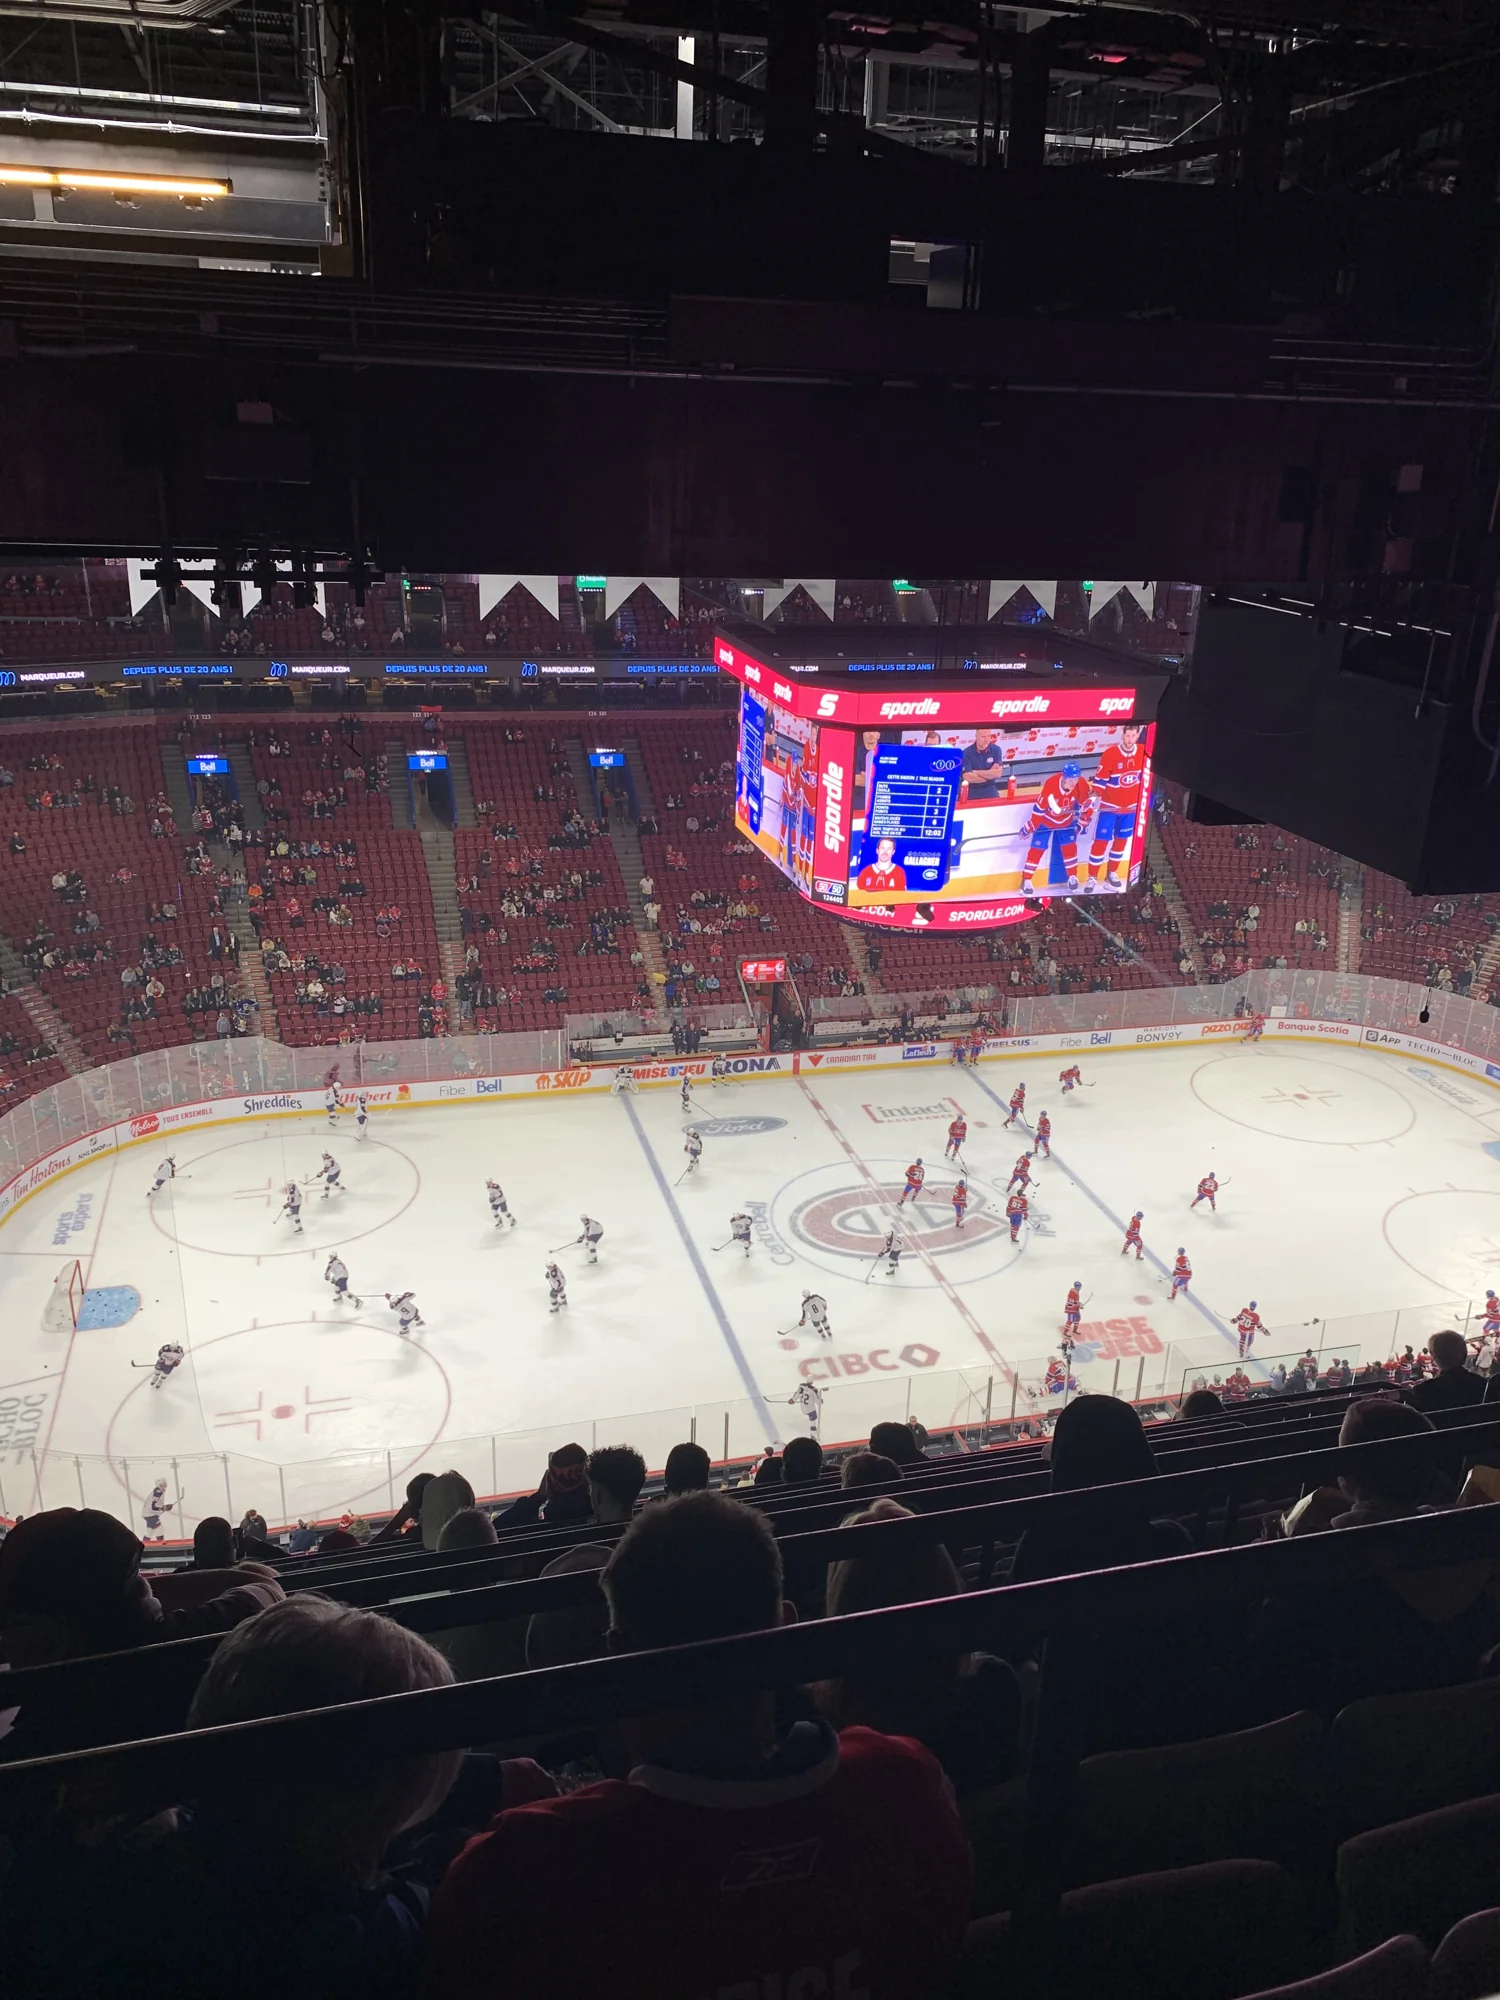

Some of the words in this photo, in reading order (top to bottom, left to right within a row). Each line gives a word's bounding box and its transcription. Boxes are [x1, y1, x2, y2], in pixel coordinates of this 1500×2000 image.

[20, 671, 85, 681] MARQUEUR.COM
[123, 666, 157, 675] DEPUIS
[158, 666, 182, 674] PLUS
[184, 666, 196, 674] DE
[197, 665, 209, 674] 20
[291, 666, 350, 674] MARQUEUR.COM
[385, 665, 417, 673] DEPUIS
[418, 665, 441, 673] PLUS
[442, 665, 454, 673] DE
[455, 665, 466, 673] 20
[880, 698, 941, 719] spordle
[991, 696, 1050, 718] spordle
[200, 762, 216, 771] Bell
[420, 758, 435, 767] Bell
[600, 756, 614, 765] Bell
[822, 761, 845, 853] spordle
[949, 904, 1025, 922] SPORDLE.COM
[1202, 1023, 1231, 1036] pizza
[1233, 1022, 1251, 1034] piz
[1277, 1021, 1316, 1033] Banque
[1318, 1023, 1349, 1035] Scotia
[986, 1039, 1031, 1049] YBELSUS
[1061, 1038, 1082, 1047] Fibe
[1090, 1032, 1112, 1045] Bell
[1136, 1031, 1182, 1043] BONVOY
[826, 1055, 860, 1064] CANADIAN
[861, 1053, 877, 1062] TIRE
[904, 1047, 935, 1058] Lafleur
[632, 1067, 669, 1080] MISE
[679, 1064, 706, 1076] JEU
[476, 1079, 502, 1094] Bell
[552, 1071, 591, 1089] SKIP
[439, 1085, 466, 1096] Fibe
[244, 1094, 303, 1114] Shreddies
[876, 1102, 952, 1118] intact
[162, 1114, 179, 1124] TOUS
[181, 1108, 213, 1120] ENSEMBLE
[129, 1119, 160, 1138] Molson
[705, 1119, 767, 1134] Ford
[11, 1179, 29, 1202] Tim
[30, 1156, 72, 1188] Hortons
[71, 1193, 94, 1232] experts
[52, 1211, 74, 1246] sports
[811, 1303, 819, 1314] 8
[1059, 1316, 1151, 1342] MISE
[1240, 1316, 1252, 1328] 20
[1096, 1334, 1165, 1361] JEU
[798, 1349, 899, 1381] CIBC
